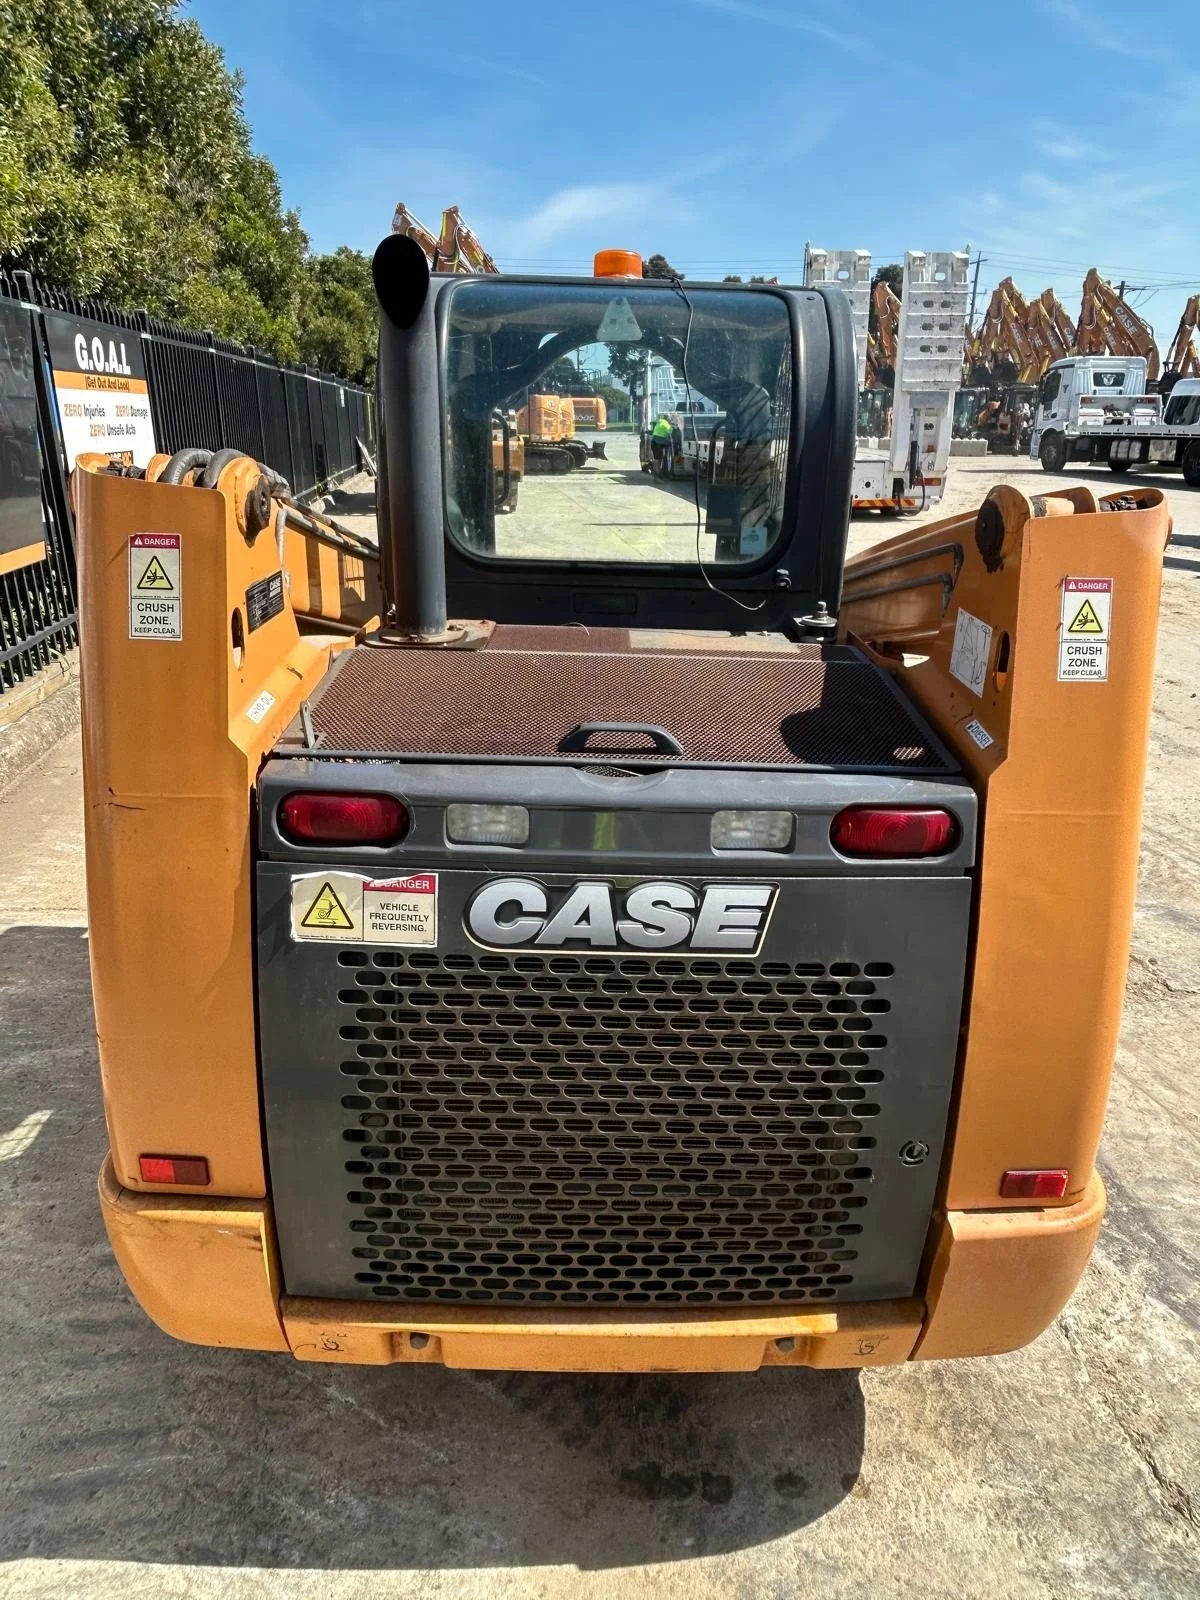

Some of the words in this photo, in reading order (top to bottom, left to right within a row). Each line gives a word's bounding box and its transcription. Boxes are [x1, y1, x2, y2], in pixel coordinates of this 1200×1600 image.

[1115, 307, 1138, 335] CASE
[1103, 327, 1116, 347] CASE
[107, 378, 117, 390] And
[63, 403, 82, 417] ZERO
[83, 403, 106, 420] Injuries
[115, 404, 130, 417] ZERO
[130, 405, 149, 419] Damage
[89, 423, 106, 437] ZERO
[106, 423, 125, 436] Unsafe
[125, 423, 136, 435] Acts
[144, 538, 176, 546] DANGER
[1077, 582, 1108, 590] DANGER
[137, 602, 175, 613] CRUSH
[139, 615, 172, 625] ZONE.
[134, 626, 152, 634] KEEP
[1066, 646, 1103, 656] CRUSH
[1068, 658, 1100, 668] ZONE.
[379, 903, 419, 912] VEHICLE
[369, 912, 430, 923] FREQUENTLY
[469, 881, 772, 949] CASE
[371, 922, 427, 932] REVERSING.
